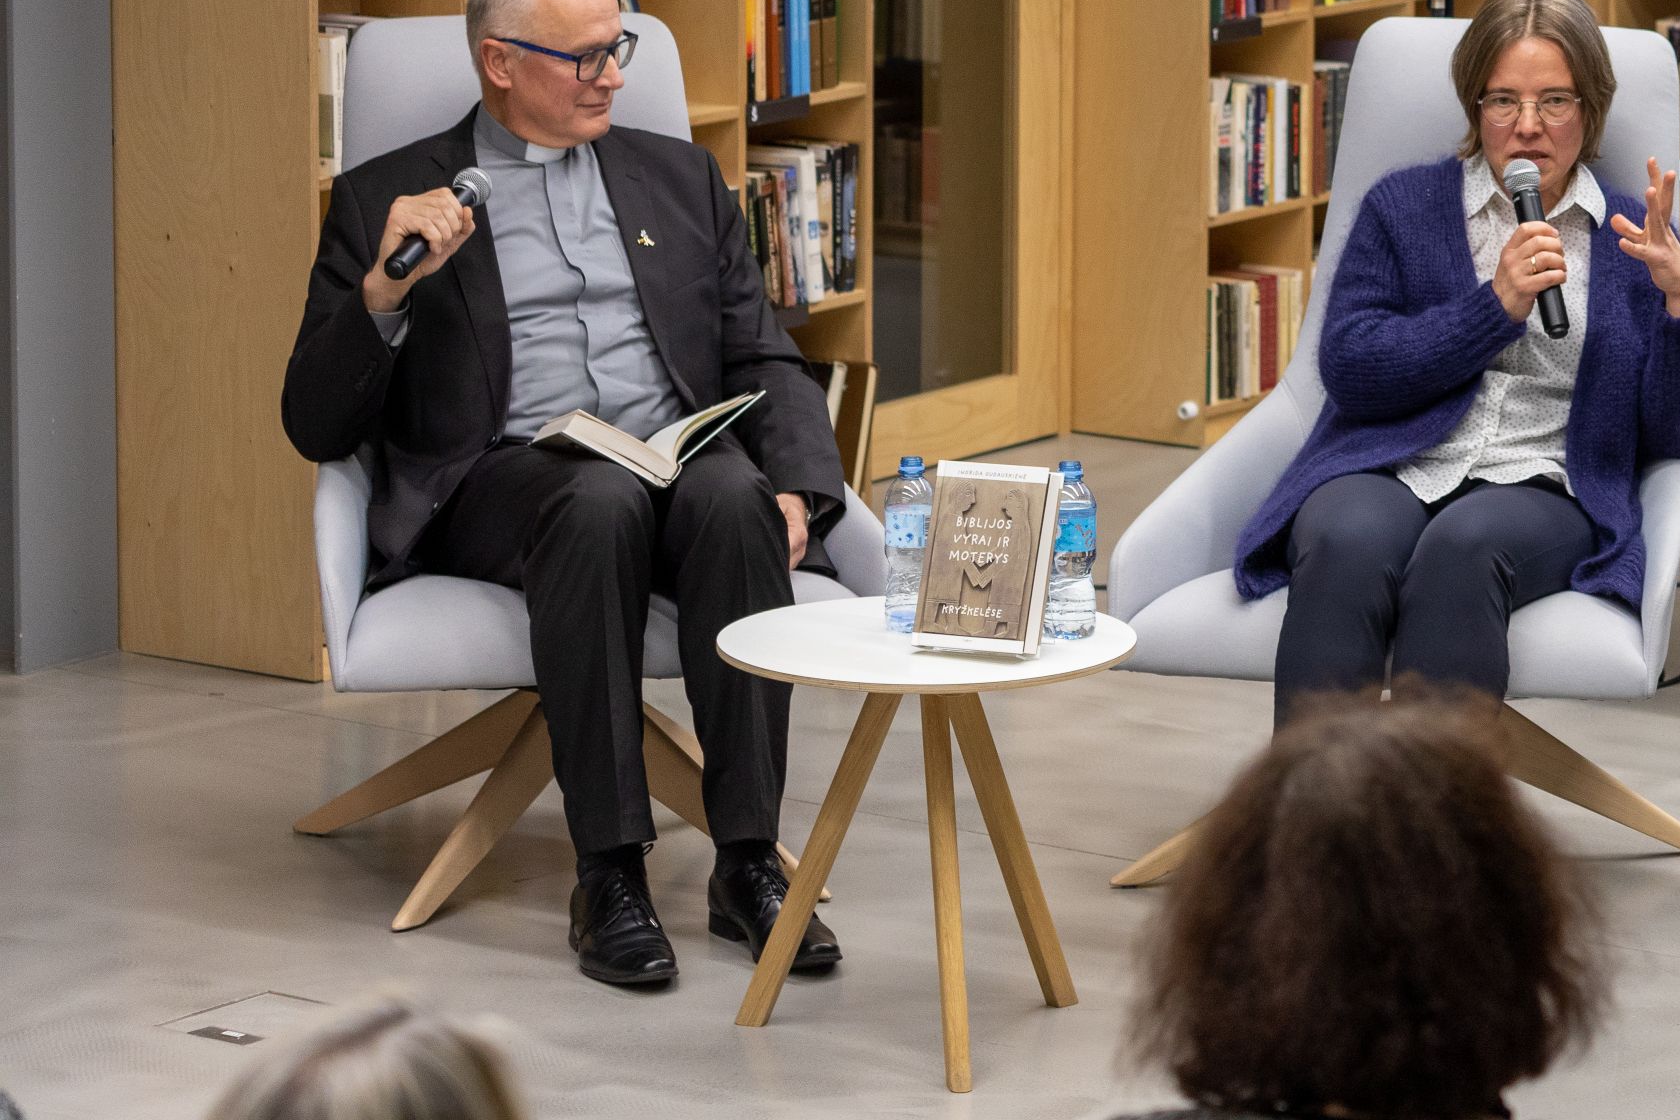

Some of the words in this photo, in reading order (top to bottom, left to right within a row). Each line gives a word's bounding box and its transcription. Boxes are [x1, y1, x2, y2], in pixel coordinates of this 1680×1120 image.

[956, 516, 1012, 530] BIBLIJOS
[953, 533, 992, 547] VYRAI
[997, 536, 1010, 548] IR
[949, 550, 1009, 564] MOTERYS
[941, 604, 1002, 619] KRYŽKELĖSE
